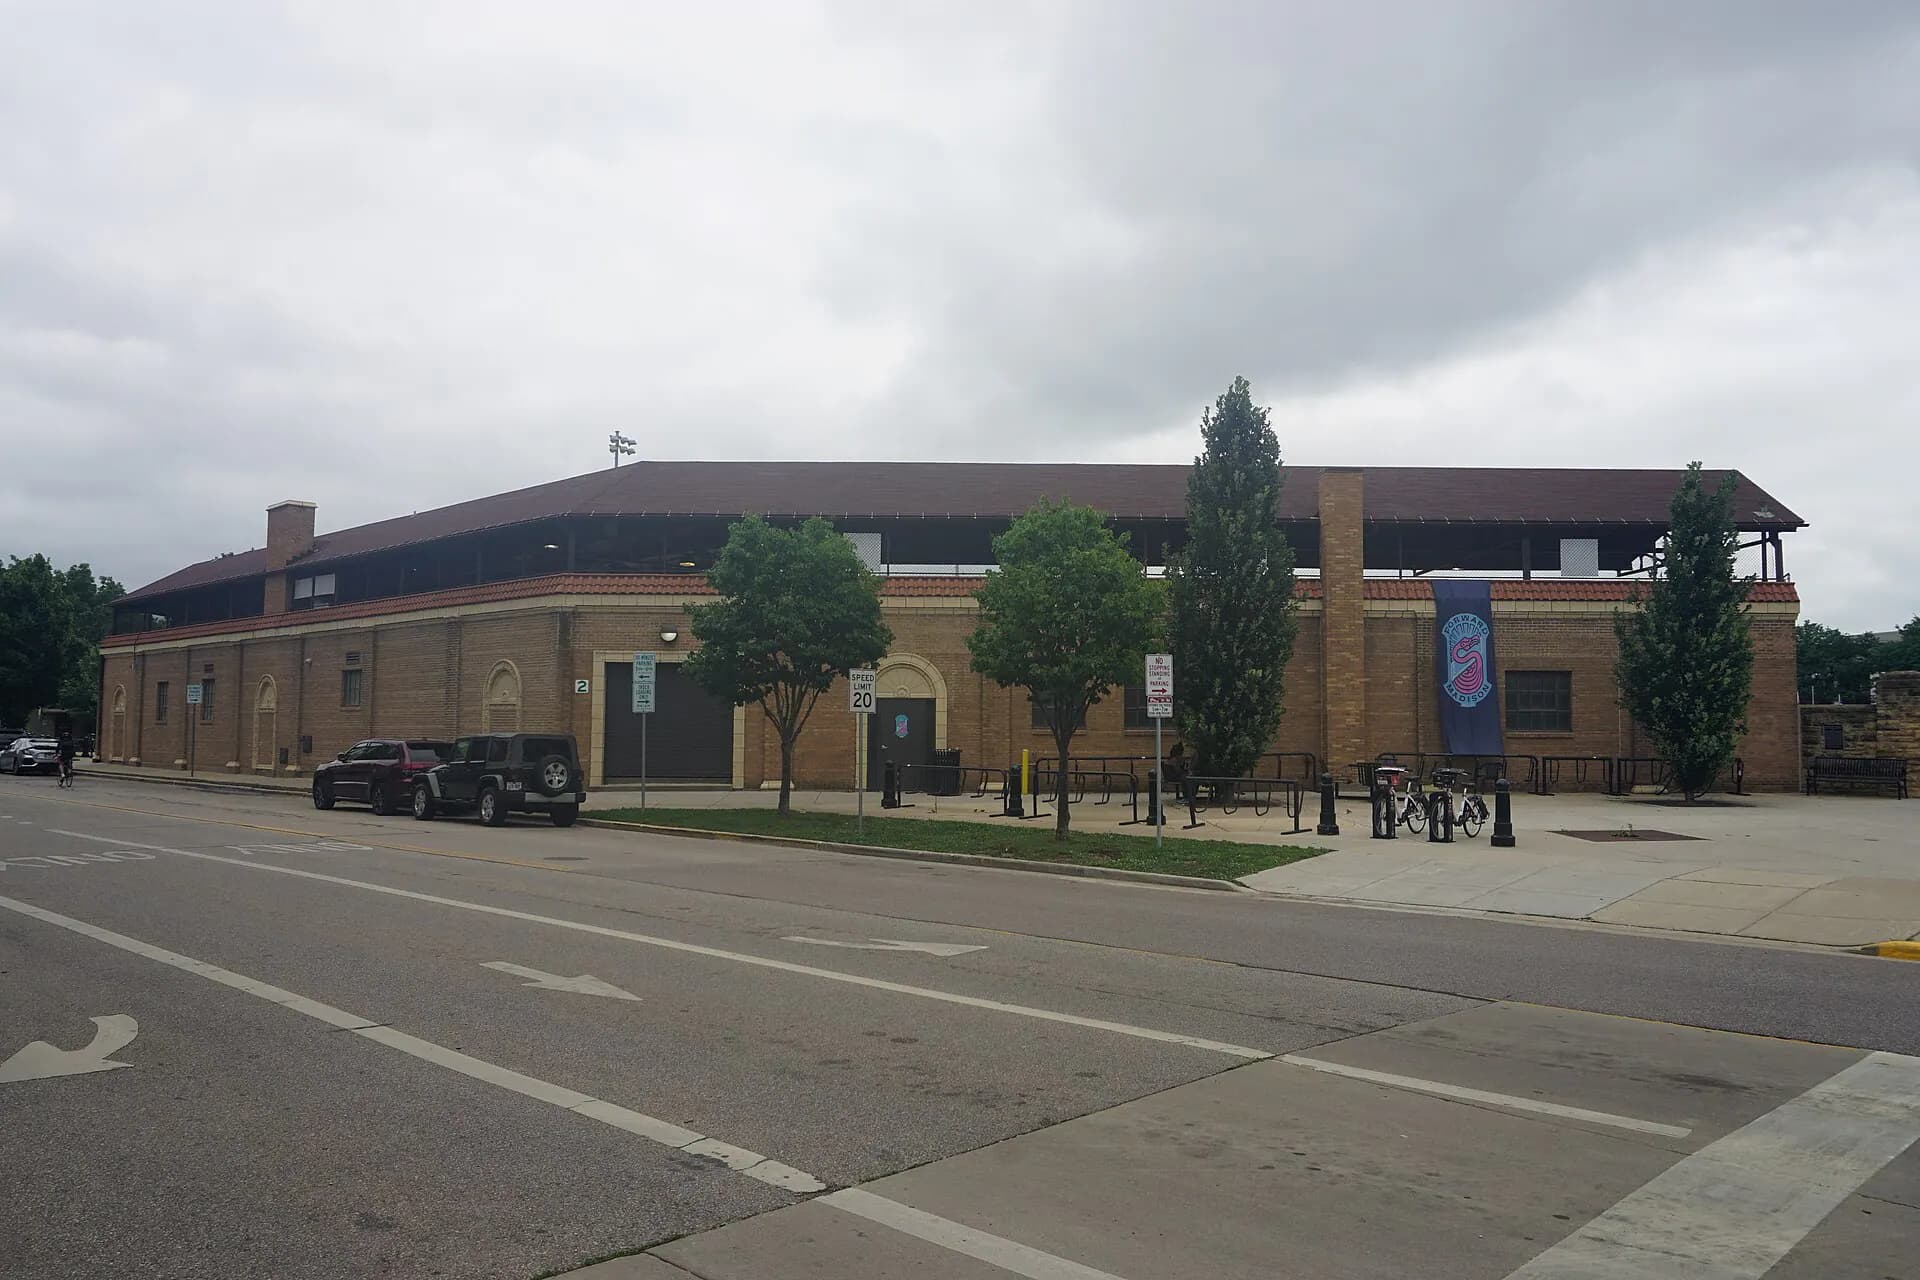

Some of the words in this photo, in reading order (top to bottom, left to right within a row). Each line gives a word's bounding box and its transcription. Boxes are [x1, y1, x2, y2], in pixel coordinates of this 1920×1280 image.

[1444, 615, 1489, 635] FORWARD
[1155, 657, 1164, 665] NO
[577, 681, 587, 692] 2
[1446, 683, 1490, 702] MADISON
[853, 692, 872, 708] 20
